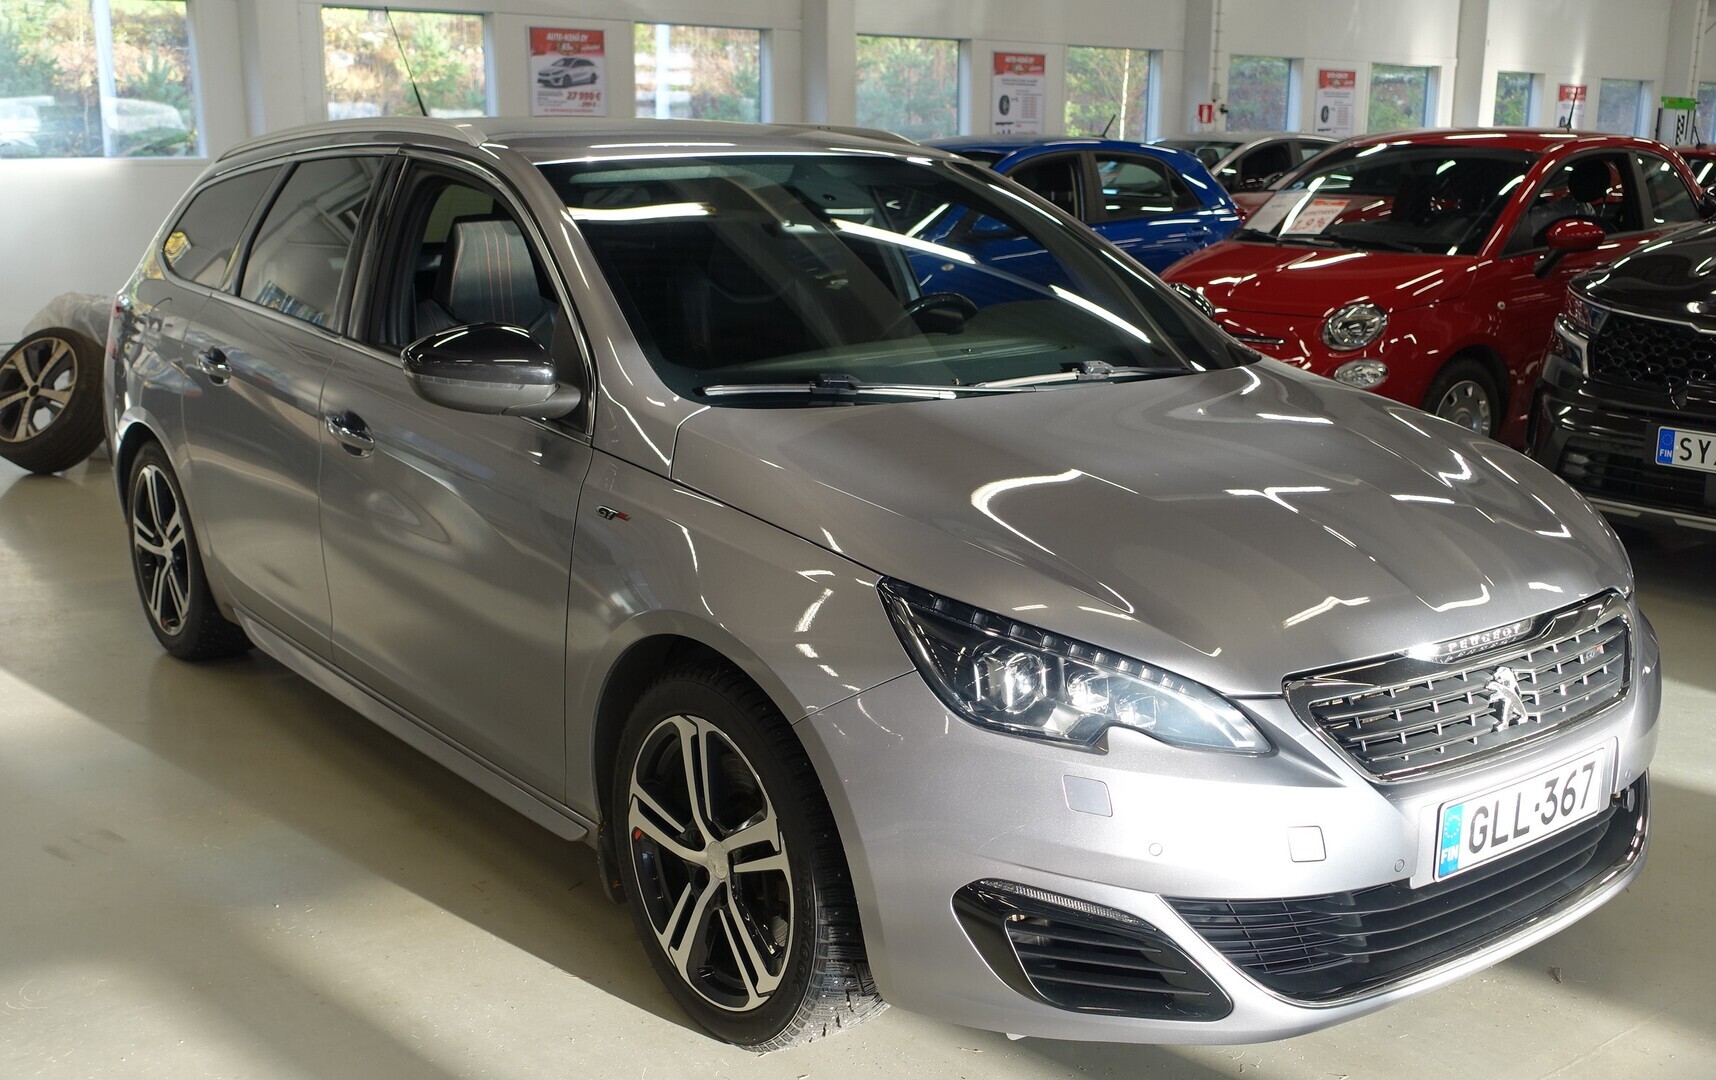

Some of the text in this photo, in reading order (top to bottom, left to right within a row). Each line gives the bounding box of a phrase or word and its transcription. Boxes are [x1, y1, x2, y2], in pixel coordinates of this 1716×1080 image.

[1659, 448, 1673, 458] FIN
[1679, 437, 1716, 465] SY
[1448, 623, 1522, 653] PEUGEOT
[1468, 760, 1597, 854] GLL-367
[1441, 844, 1460, 864] FIN
